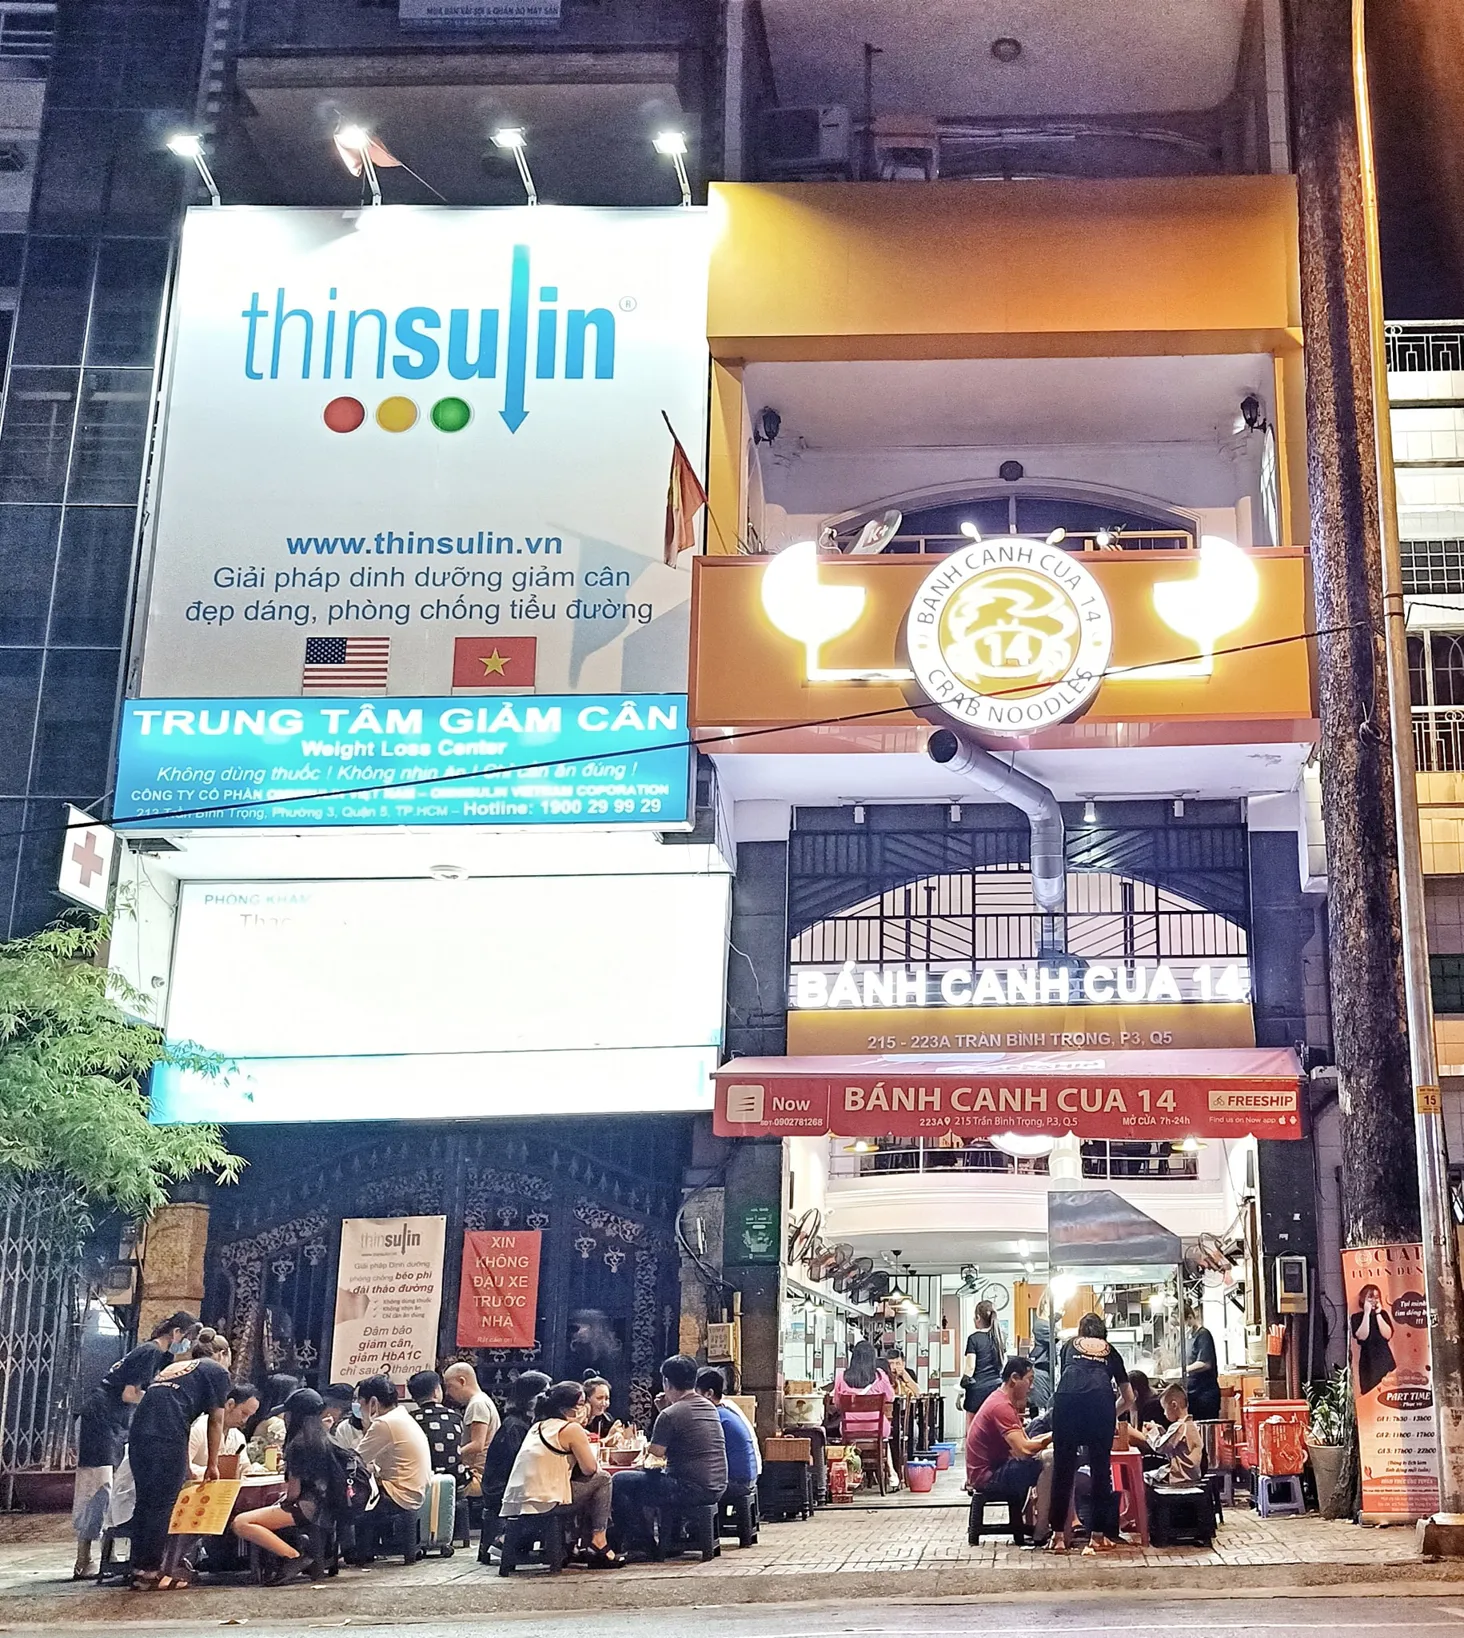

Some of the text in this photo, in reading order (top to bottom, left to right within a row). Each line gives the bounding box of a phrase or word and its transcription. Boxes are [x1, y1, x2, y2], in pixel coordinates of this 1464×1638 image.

[241, 244, 616, 434] thinsulin
[286, 532, 563, 556] www.thinsulin.vn
[213, 566, 631, 593] Giải pháp dinh dưỡng giảm cân
[965, 546, 1033, 570] CANH
[1040, 554, 1082, 590] CUA
[1081, 596, 1101, 622] 14
[185, 594, 653, 626] đẹp dáng, phòng chống tiểu đường
[928, 667, 1093, 724] CRAB NOODLES
[133, 701, 678, 736] TRUNG TÂM GIẢM CÂN
[301, 739, 508, 760] Weight Loss Center
[156, 766, 215, 785] Không
[221, 767, 266, 785] dùng
[270, 763, 321, 780] thuốc
[337, 765, 396, 783] Không
[582, 761, 627, 781] đúng
[131, 788, 173, 801] CÔNG
[177, 790, 196, 801] TY
[540, 799, 582, 814] 1900
[587, 799, 609, 814] 29
[613, 799, 635, 813] 99
[639, 798, 662, 813] 29
[797, 961, 1250, 1008] BÁNH CANH CUA 14
[867, 1036, 896, 1050] 215
[910, 1035, 951, 1049] 223A
[1007, 1030, 1045, 1047] BÌNH
[1120, 1033, 1145, 1047] P3,
[1149, 1032, 1173, 1046] Q5
[772, 1096, 810, 1111] Now
[844, 1082, 1177, 1113] BÁNH CANH CUA 14
[1228, 1095, 1293, 1107] FREESHIP
[1424, 1095, 1437, 1105] 15
[920, 1118, 943, 1127] 223A
[954, 1116, 971, 1126] 215
[360, 1223, 421, 1256] thinsulin
[491, 1236, 516, 1248] XIN
[475, 1253, 529, 1268] KHÔNG
[1414, 1246, 1424, 1261] 1
[508, 1275, 529, 1288] XE
[482, 1312, 514, 1327] NHÀ
[381, 1350, 422, 1362] HbA1C
[358, 1366, 379, 1376] sau
[1386, 1391, 1431, 1401] PART TIME
